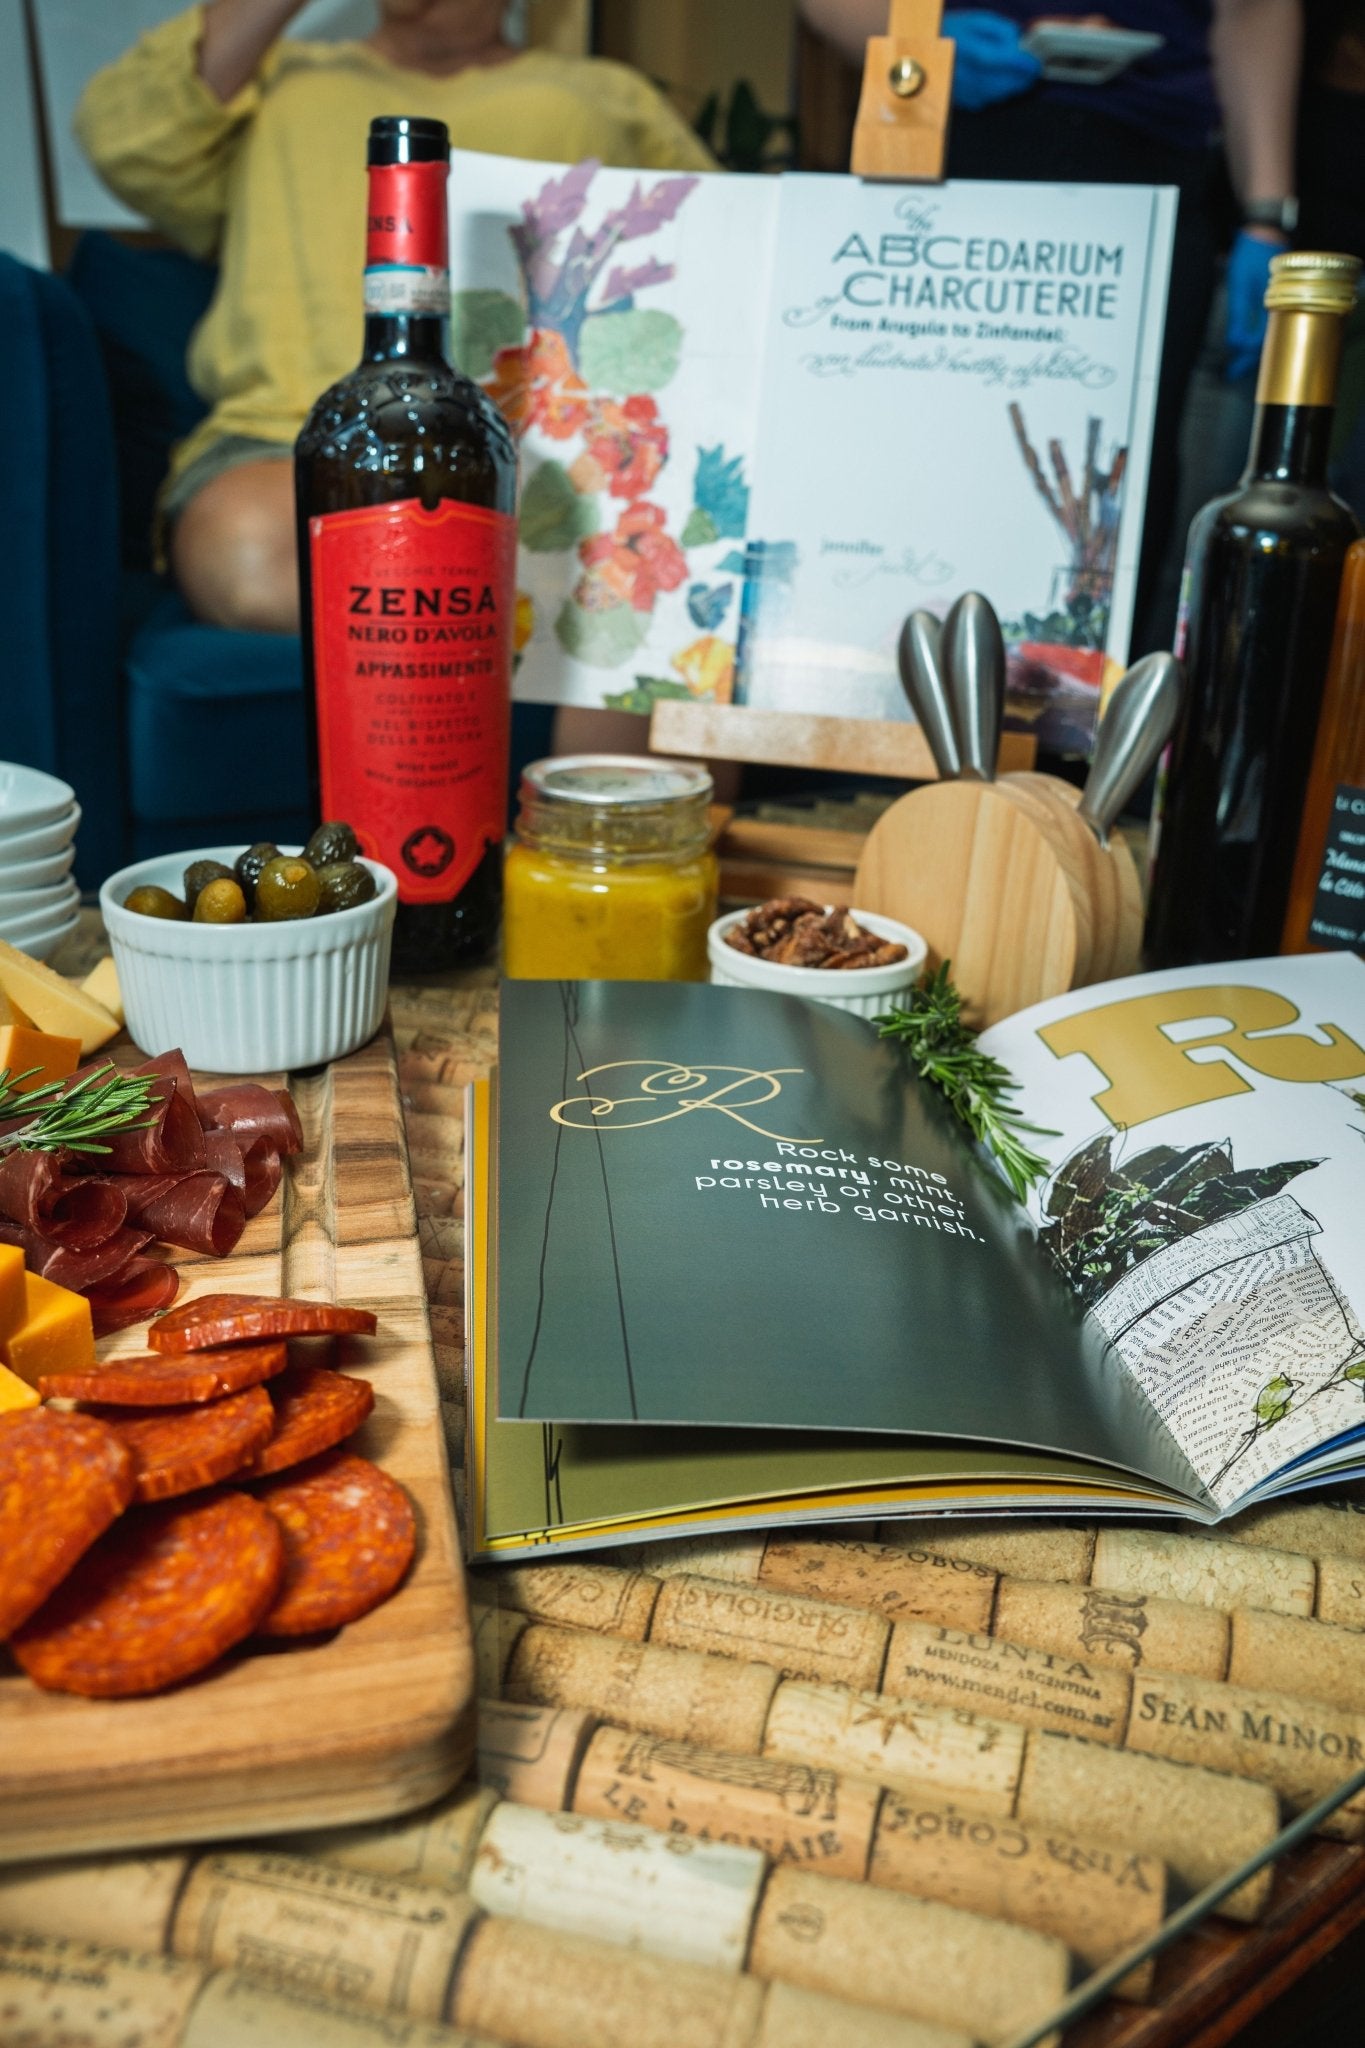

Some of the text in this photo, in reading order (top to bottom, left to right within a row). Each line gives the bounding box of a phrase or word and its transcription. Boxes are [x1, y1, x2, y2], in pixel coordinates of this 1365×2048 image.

[831, 232, 1124, 277] ABCEDARIUM
[842, 270, 1118, 319] CHARCUTERIE
[831, 314, 871, 332] From
[952, 321, 971, 337] to
[349, 585, 496, 616] ZENSA
[348, 623, 497, 644] NERO D'AVOLA
[356, 659, 493, 679] APPASSIMENTO
[1035, 984, 1365, 1132] R
[710, 1158, 965, 1207] rosemary, mint,
[776, 1141, 947, 1185] Rock some
[695, 1173, 967, 1222] parsley or other
[760, 1193, 987, 1243] herb garnish.
[679, 1585, 851, 1643] ARGIOLAS
[924, 1646, 1103, 1701] MENDOZA ARGENTINA
[935, 1628, 1095, 1680] LUNTA
[1138, 1692, 1226, 1733] SEAN
[1242, 1710, 1365, 1763] MINOR
